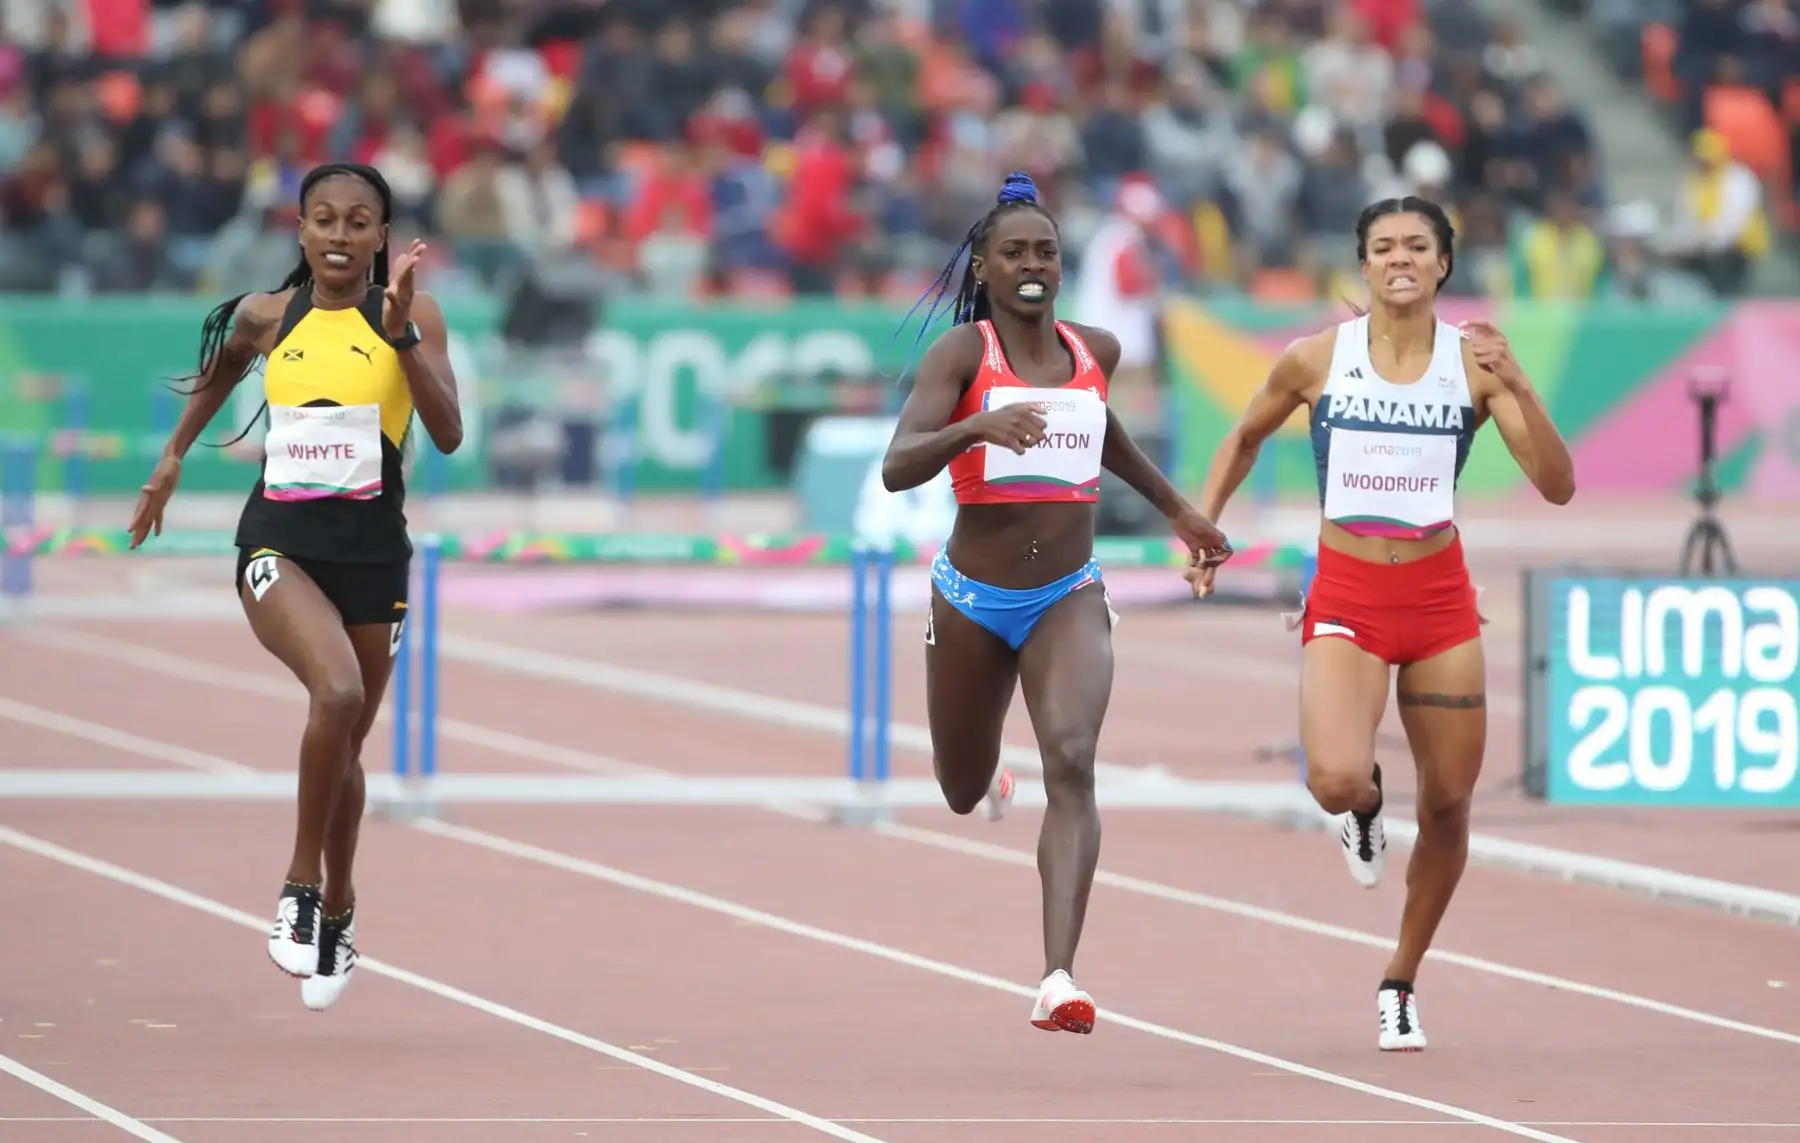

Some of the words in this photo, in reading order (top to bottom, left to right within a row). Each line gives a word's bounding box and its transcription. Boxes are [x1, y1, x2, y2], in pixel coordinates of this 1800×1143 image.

[1328, 395, 1464, 430] PANAMA
[287, 443, 356, 460] WHYTE
[1342, 471, 1440, 493] WOODRUFF
[1567, 685, 1799, 793] 2019
